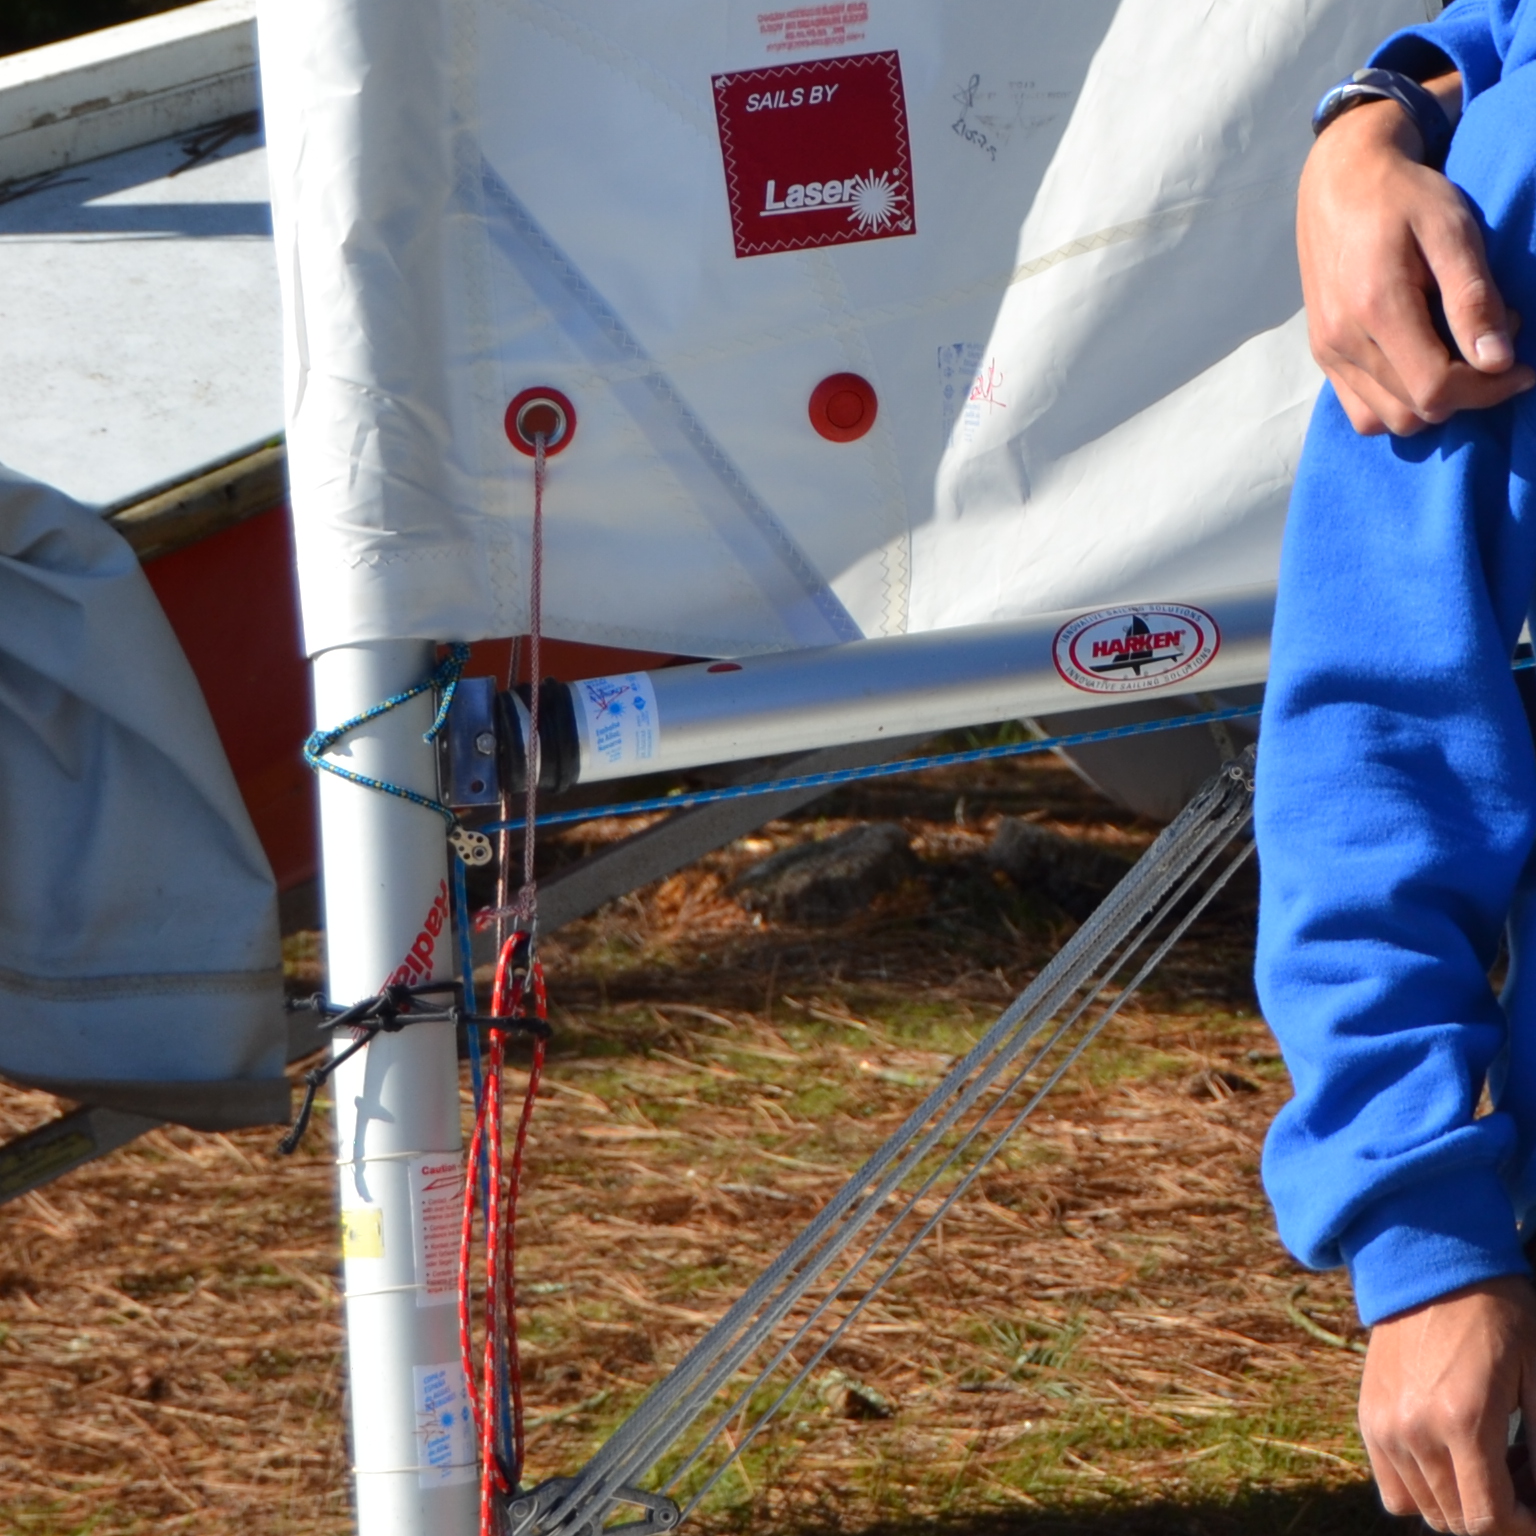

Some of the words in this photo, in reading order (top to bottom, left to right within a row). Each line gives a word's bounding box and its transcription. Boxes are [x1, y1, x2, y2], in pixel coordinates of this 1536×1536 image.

[745, 87, 805, 112] SAILS
[809, 83, 839, 105] BY
[765, 178, 857, 211] Laser
[1060, 613, 1102, 643] INNOVATIVE
[1105, 605, 1145, 615] SAILING
[1150, 604, 1203, 622] SOLUTIONS
[1092, 631, 1181, 657] HARKEN
[1065, 666, 1117, 690] INNOVATIVE
[1119, 677, 1160, 690] SAILING
[1163, 646, 1212, 682] SOLUTIONS
[421, 1164, 457, 1176] Caution
